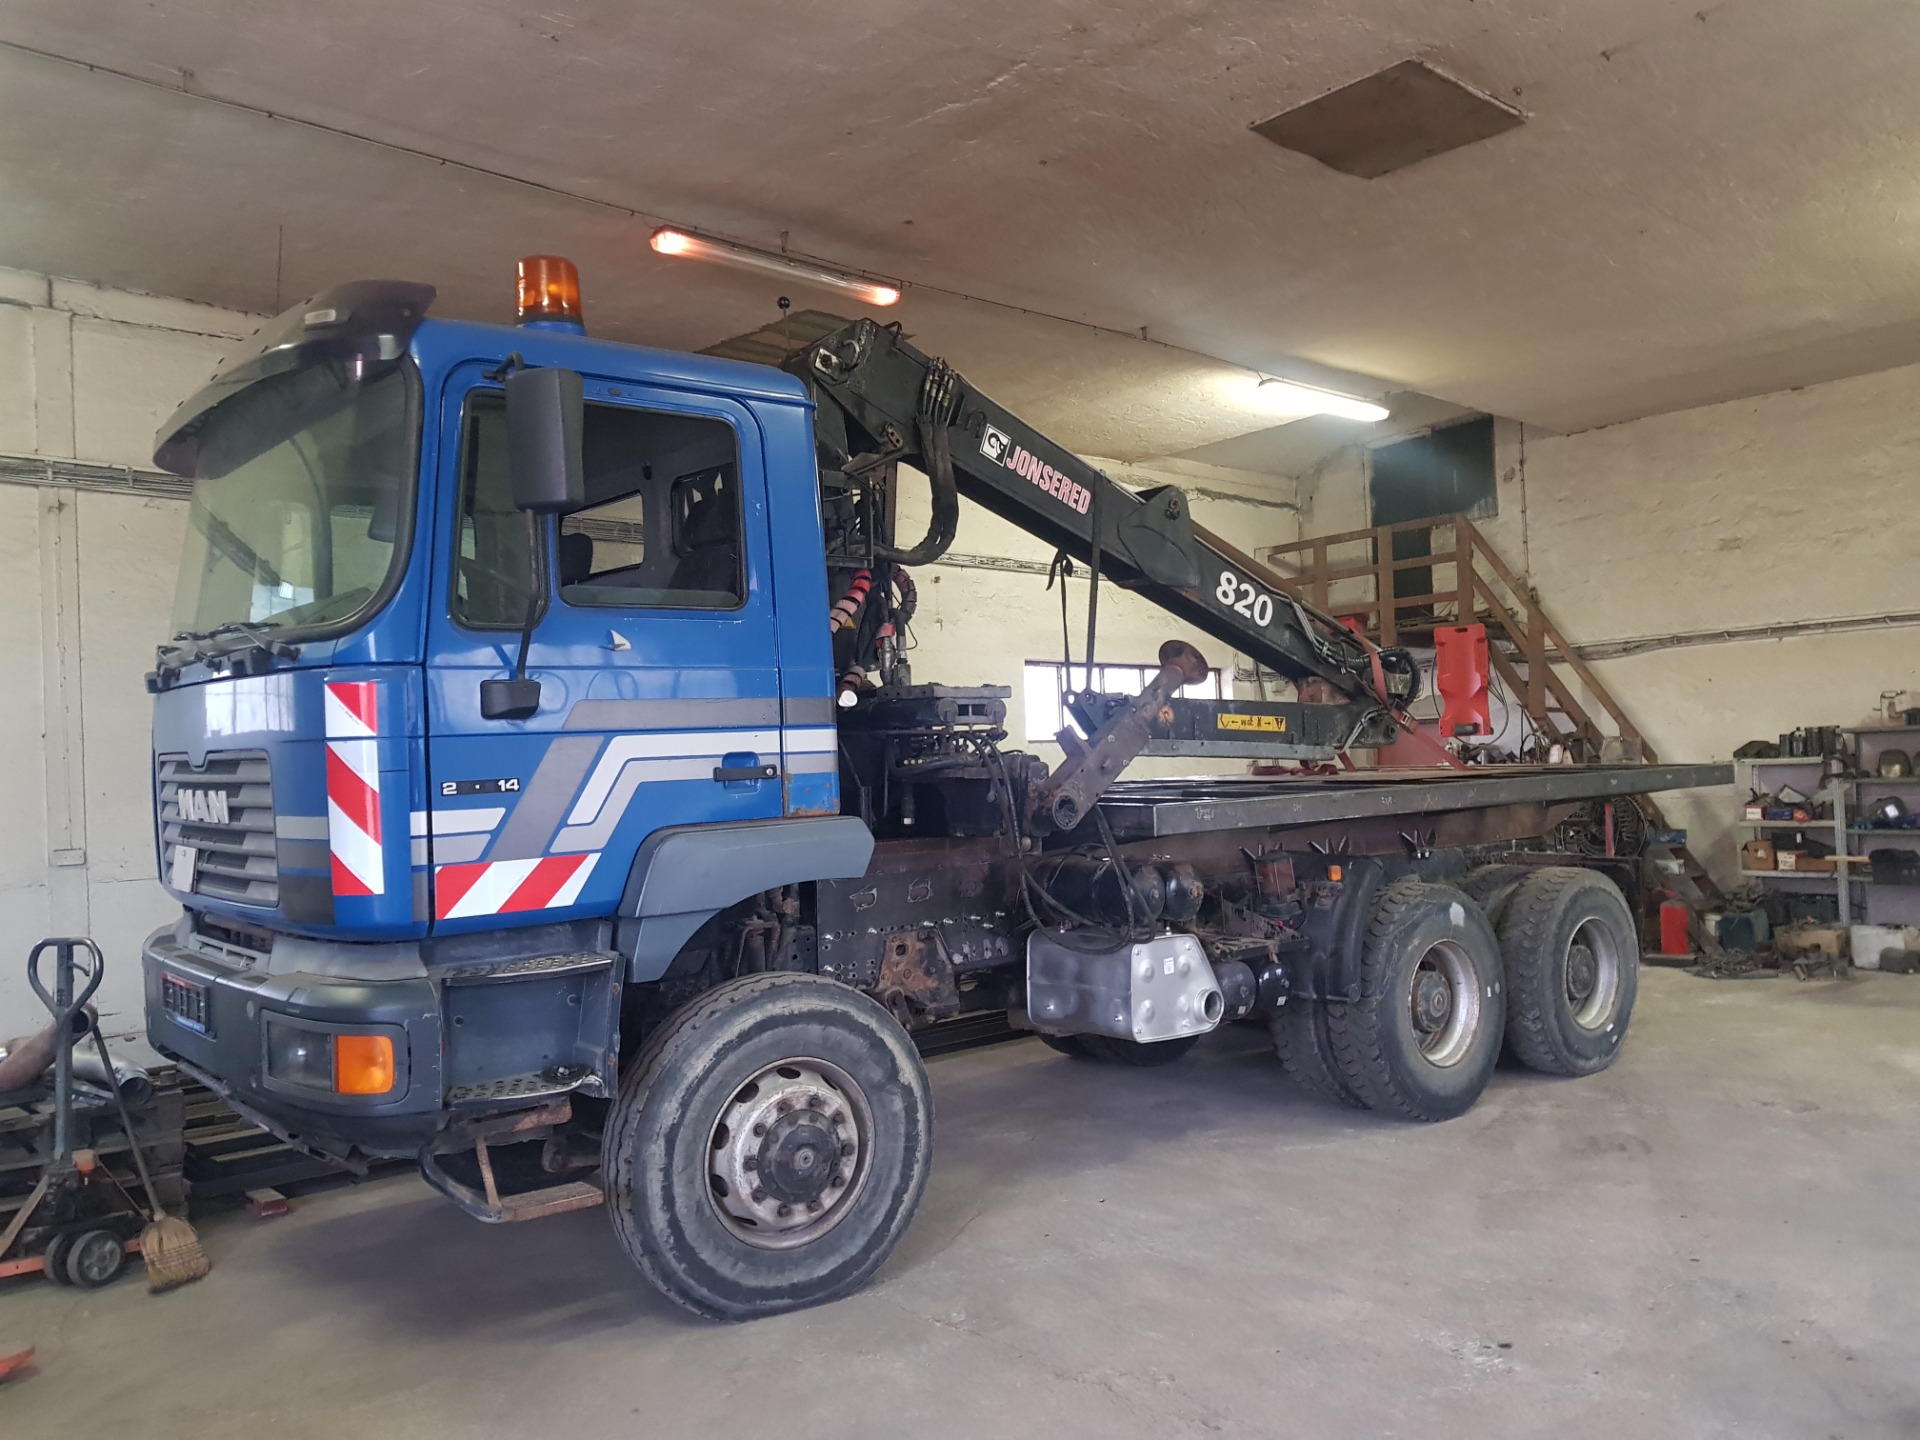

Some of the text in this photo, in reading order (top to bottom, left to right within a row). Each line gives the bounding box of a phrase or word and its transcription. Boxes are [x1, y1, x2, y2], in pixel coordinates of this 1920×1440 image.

[1006, 445, 1092, 515] JONSERED
[1215, 570, 1274, 628] 820
[177, 788, 230, 824] MAN
